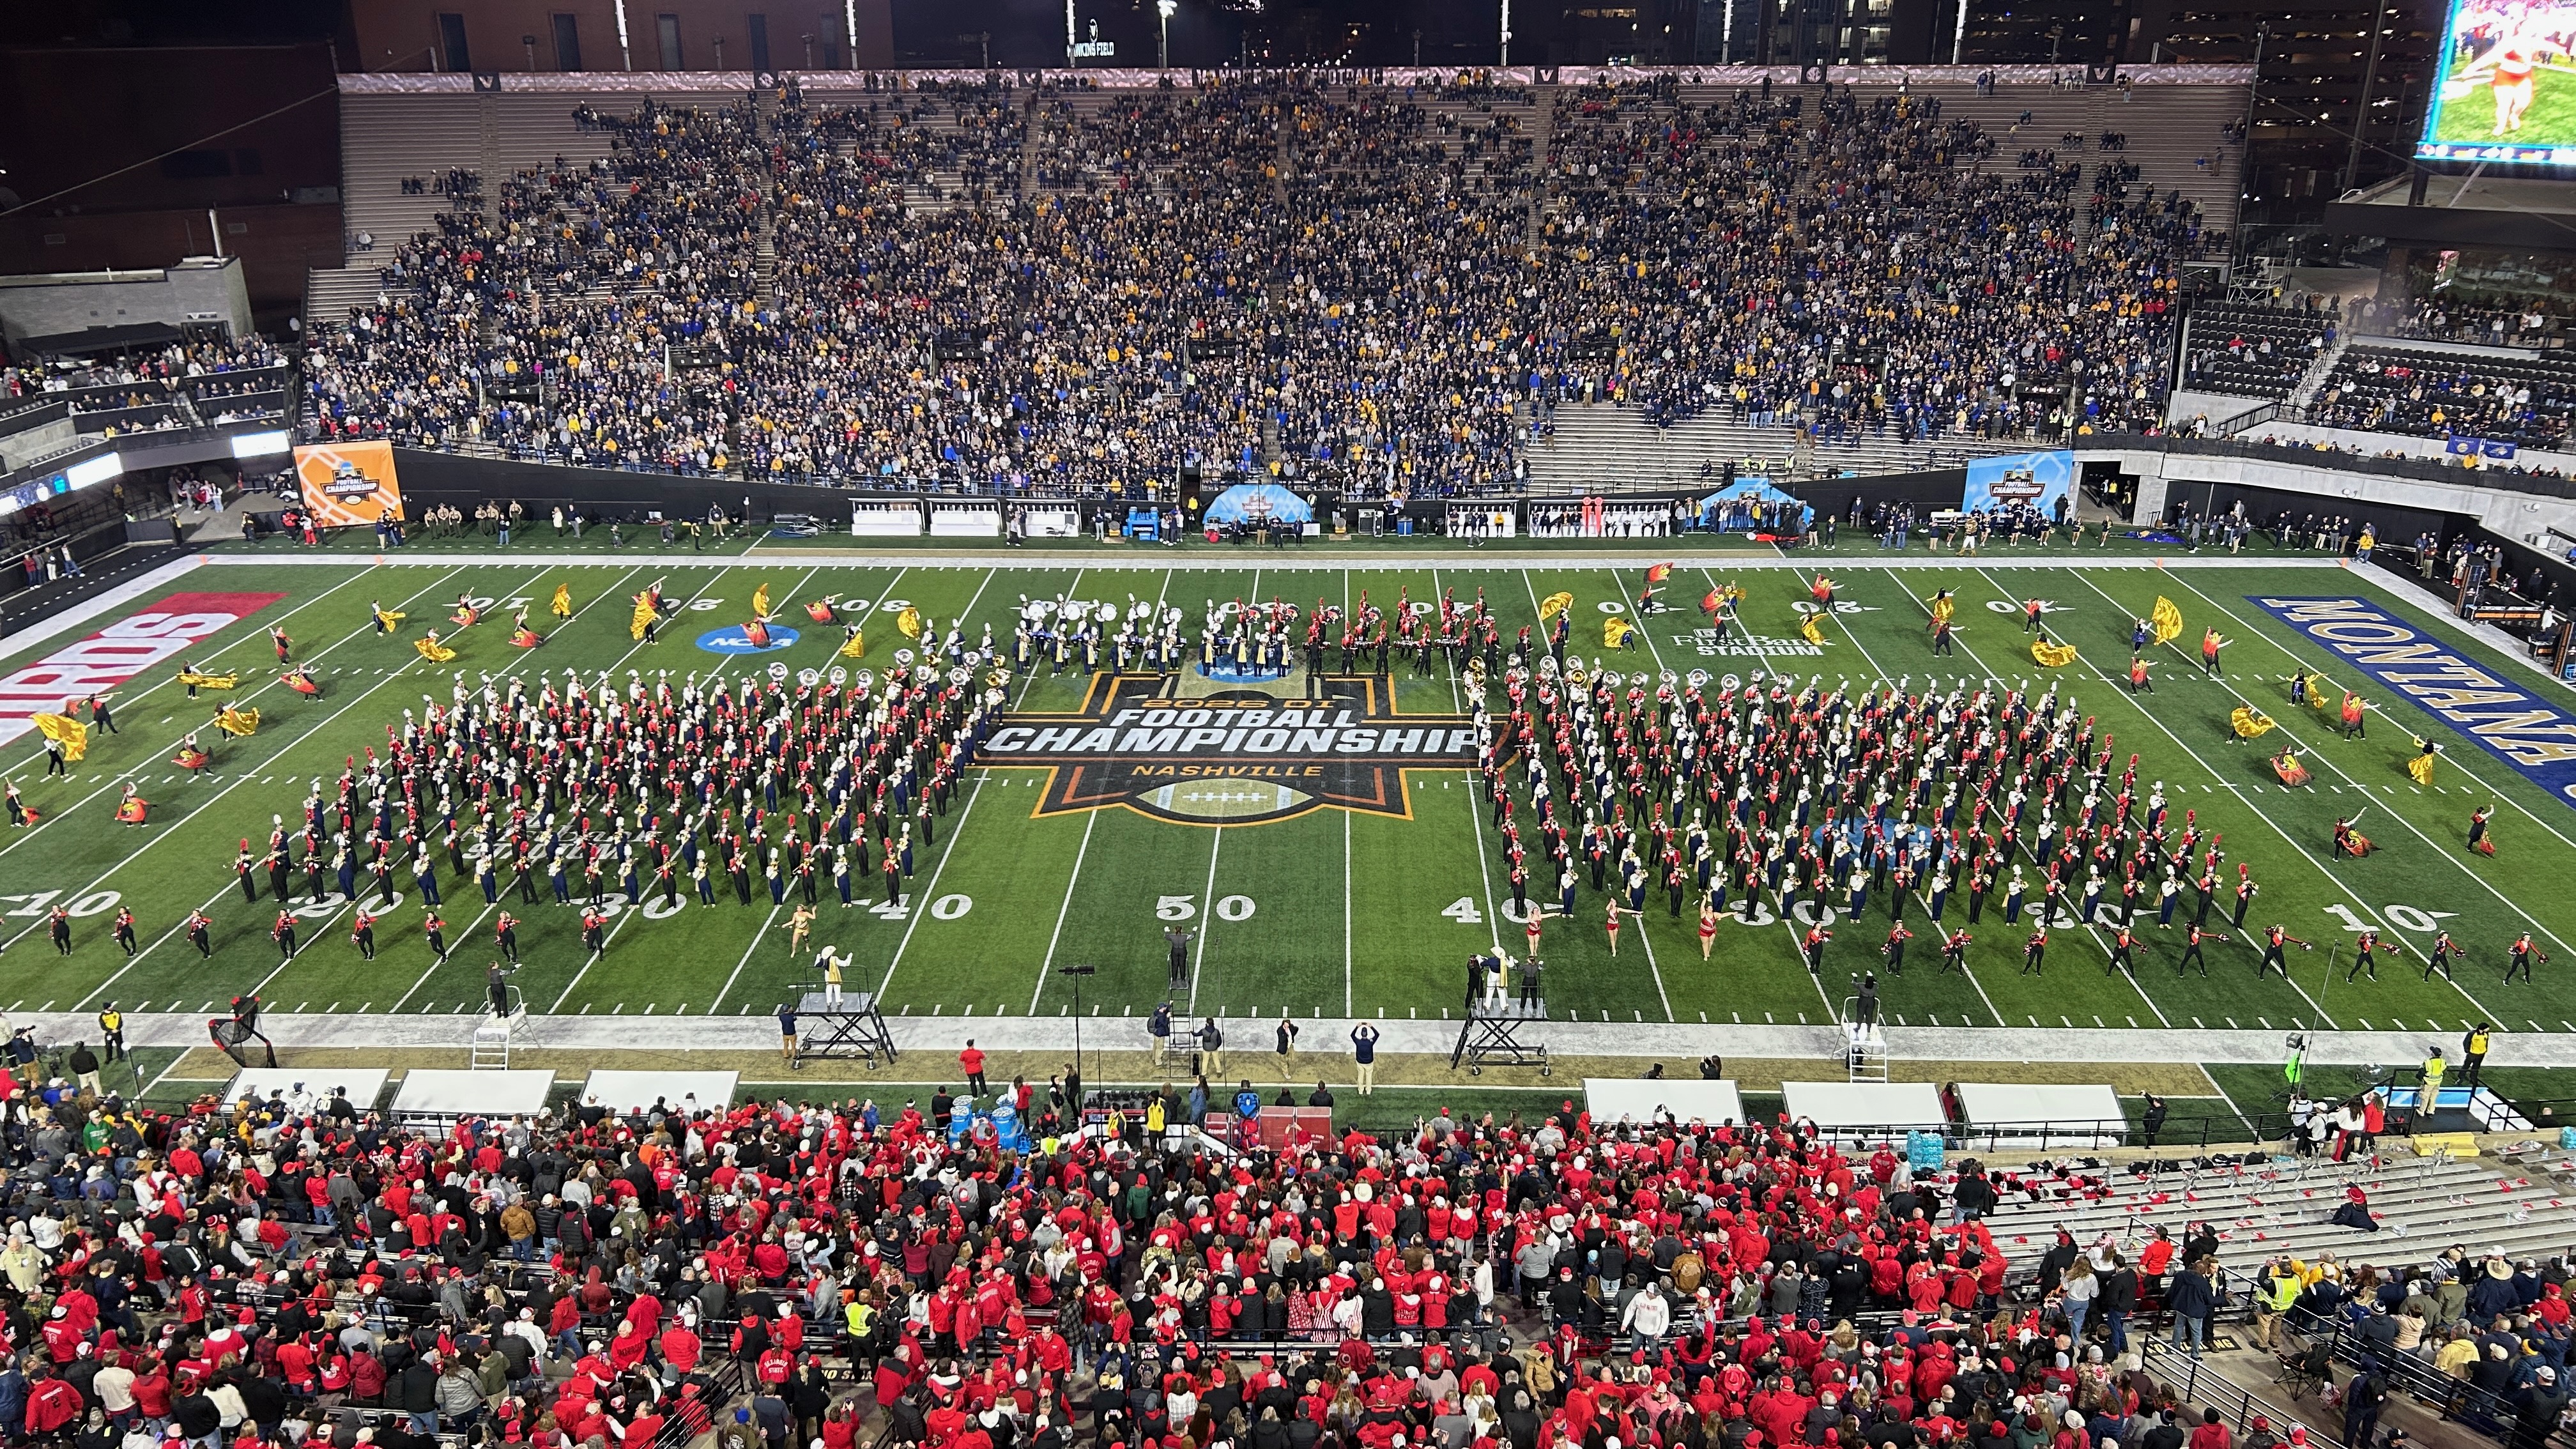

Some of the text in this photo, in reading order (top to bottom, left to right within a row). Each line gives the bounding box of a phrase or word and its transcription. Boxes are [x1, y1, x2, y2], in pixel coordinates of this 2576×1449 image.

[1066, 42, 1114, 57] HWKINS FIELD
[1540, 69, 1554, 82] V
[2094, 67, 2110, 80] V
[479, 76, 493, 88] V
[326, 482, 377, 493] CHAMPIONSHIP
[707, 638, 793, 647] NCA
[1696, 646, 1825, 656] STADIUM
[2260, 598, 2576, 766] MONTANA
[1142, 699, 1269, 709] 2026
[1109, 709, 1358, 728] FOOTBALL
[984, 727, 1482, 754] CHAMPIONSHIP
[1131, 765, 1324, 778] NASHVILLE
[6, 889, 121, 917] 10
[289, 891, 404, 918] 20
[579, 893, 687, 919] 30
[869, 893, 973, 921] 40
[1155, 894, 1256, 921] 50
[2322, 903, 2438, 932] 10
[764, 1358, 788, 1368] ILLINOIS
